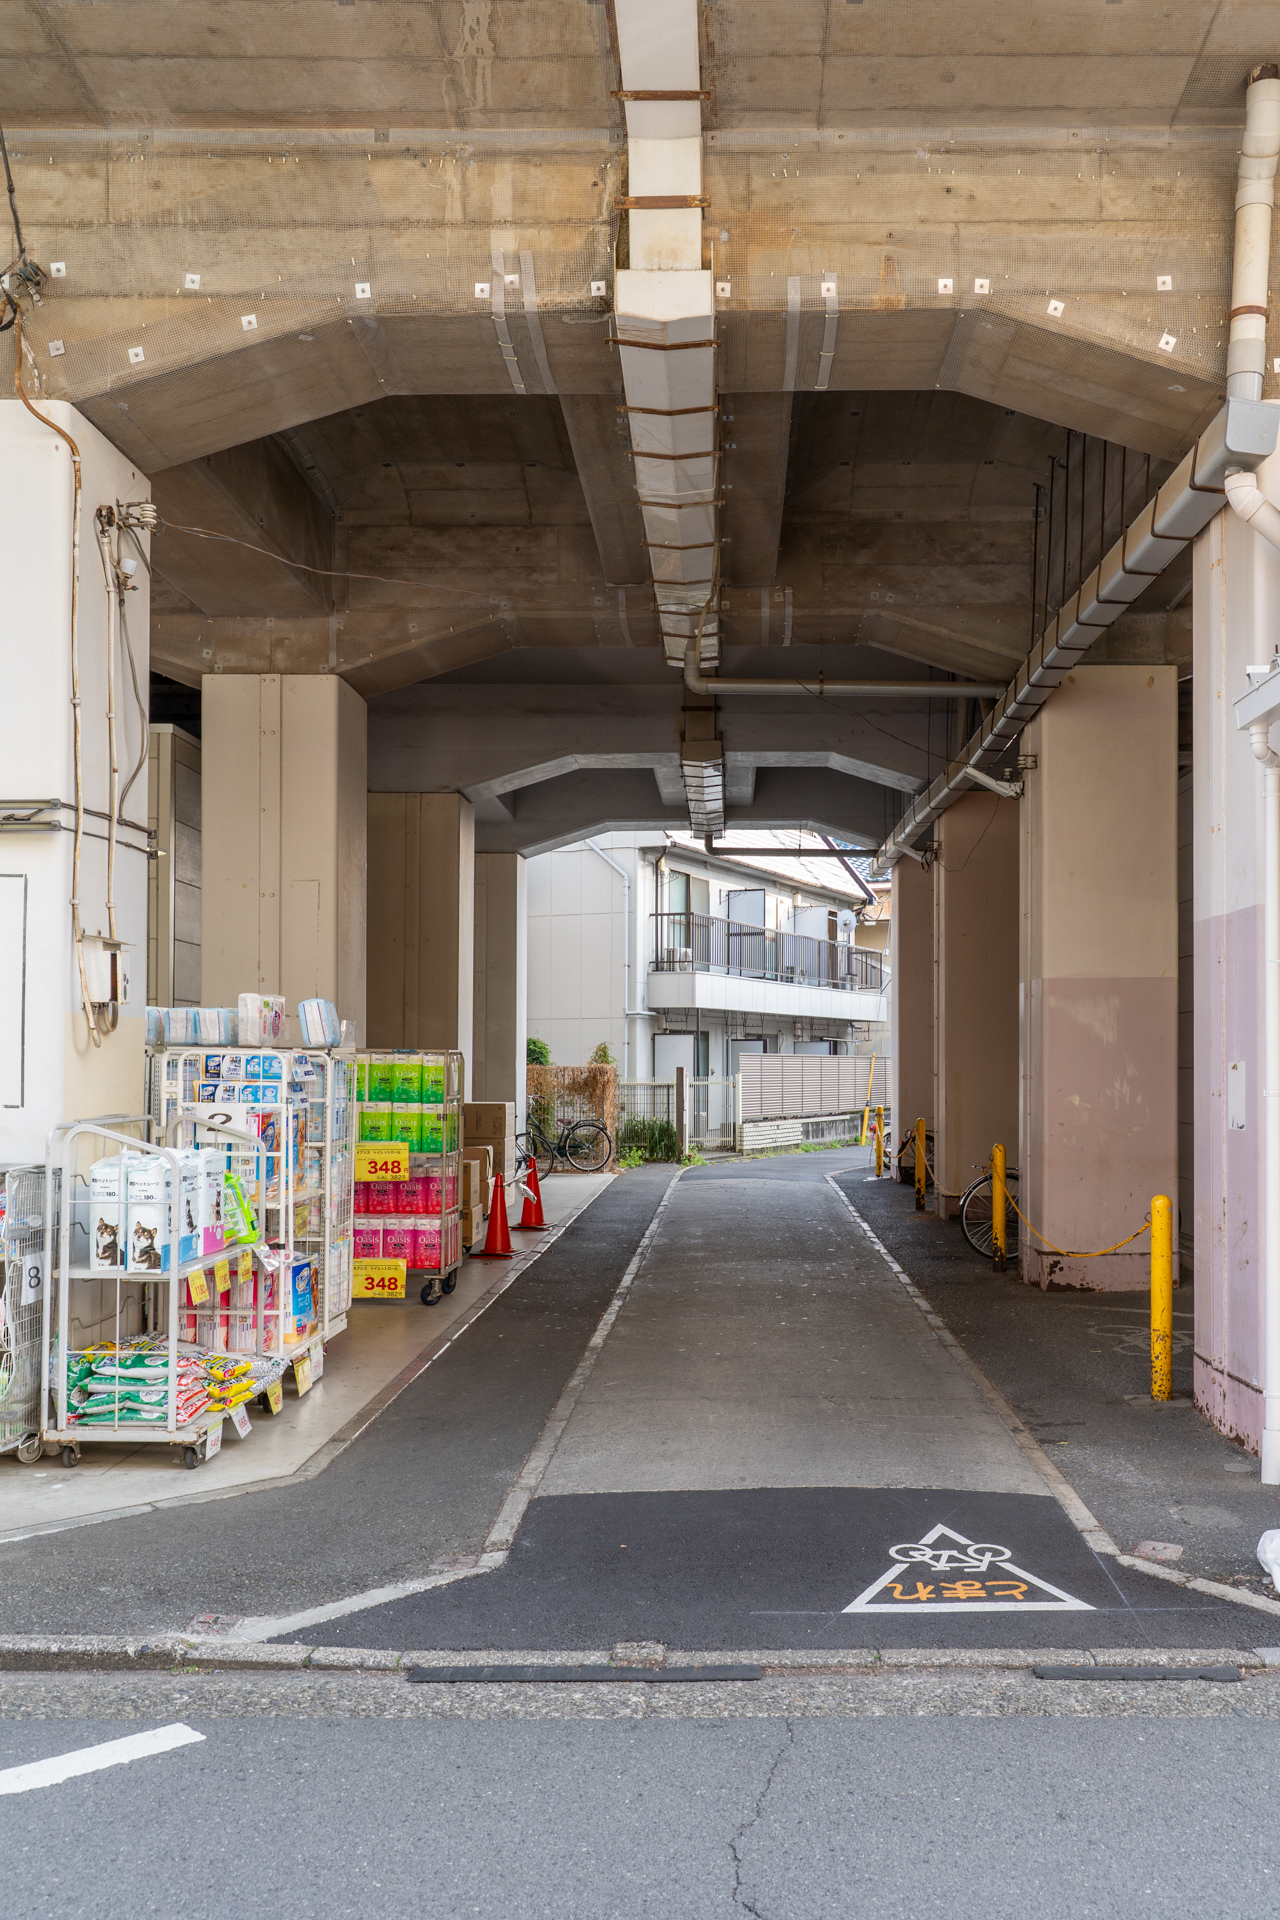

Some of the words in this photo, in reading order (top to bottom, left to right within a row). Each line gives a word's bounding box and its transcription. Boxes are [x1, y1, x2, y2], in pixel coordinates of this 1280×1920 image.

[395, 1069, 418, 1078] Oasis
[424, 1072, 443, 1080] Oasi
[206, 1112, 233, 1132] 2
[364, 1118, 387, 1127] Oasis
[394, 1118, 418, 1127] Oasis
[424, 1119, 443, 1128] Oasi
[367, 1160, 402, 1175] 348
[370, 1182, 394, 1190] Oasis
[399, 1183, 423, 1191] Oasis
[356, 1235, 380, 1244] Oasis
[387, 1235, 411, 1244] Oasis
[418, 1235, 442, 1244] Oasis
[28, 1265, 42, 1289] 8
[364, 1276, 399, 1291] 348
[886, 1580, 1029, 1601] とまれ
